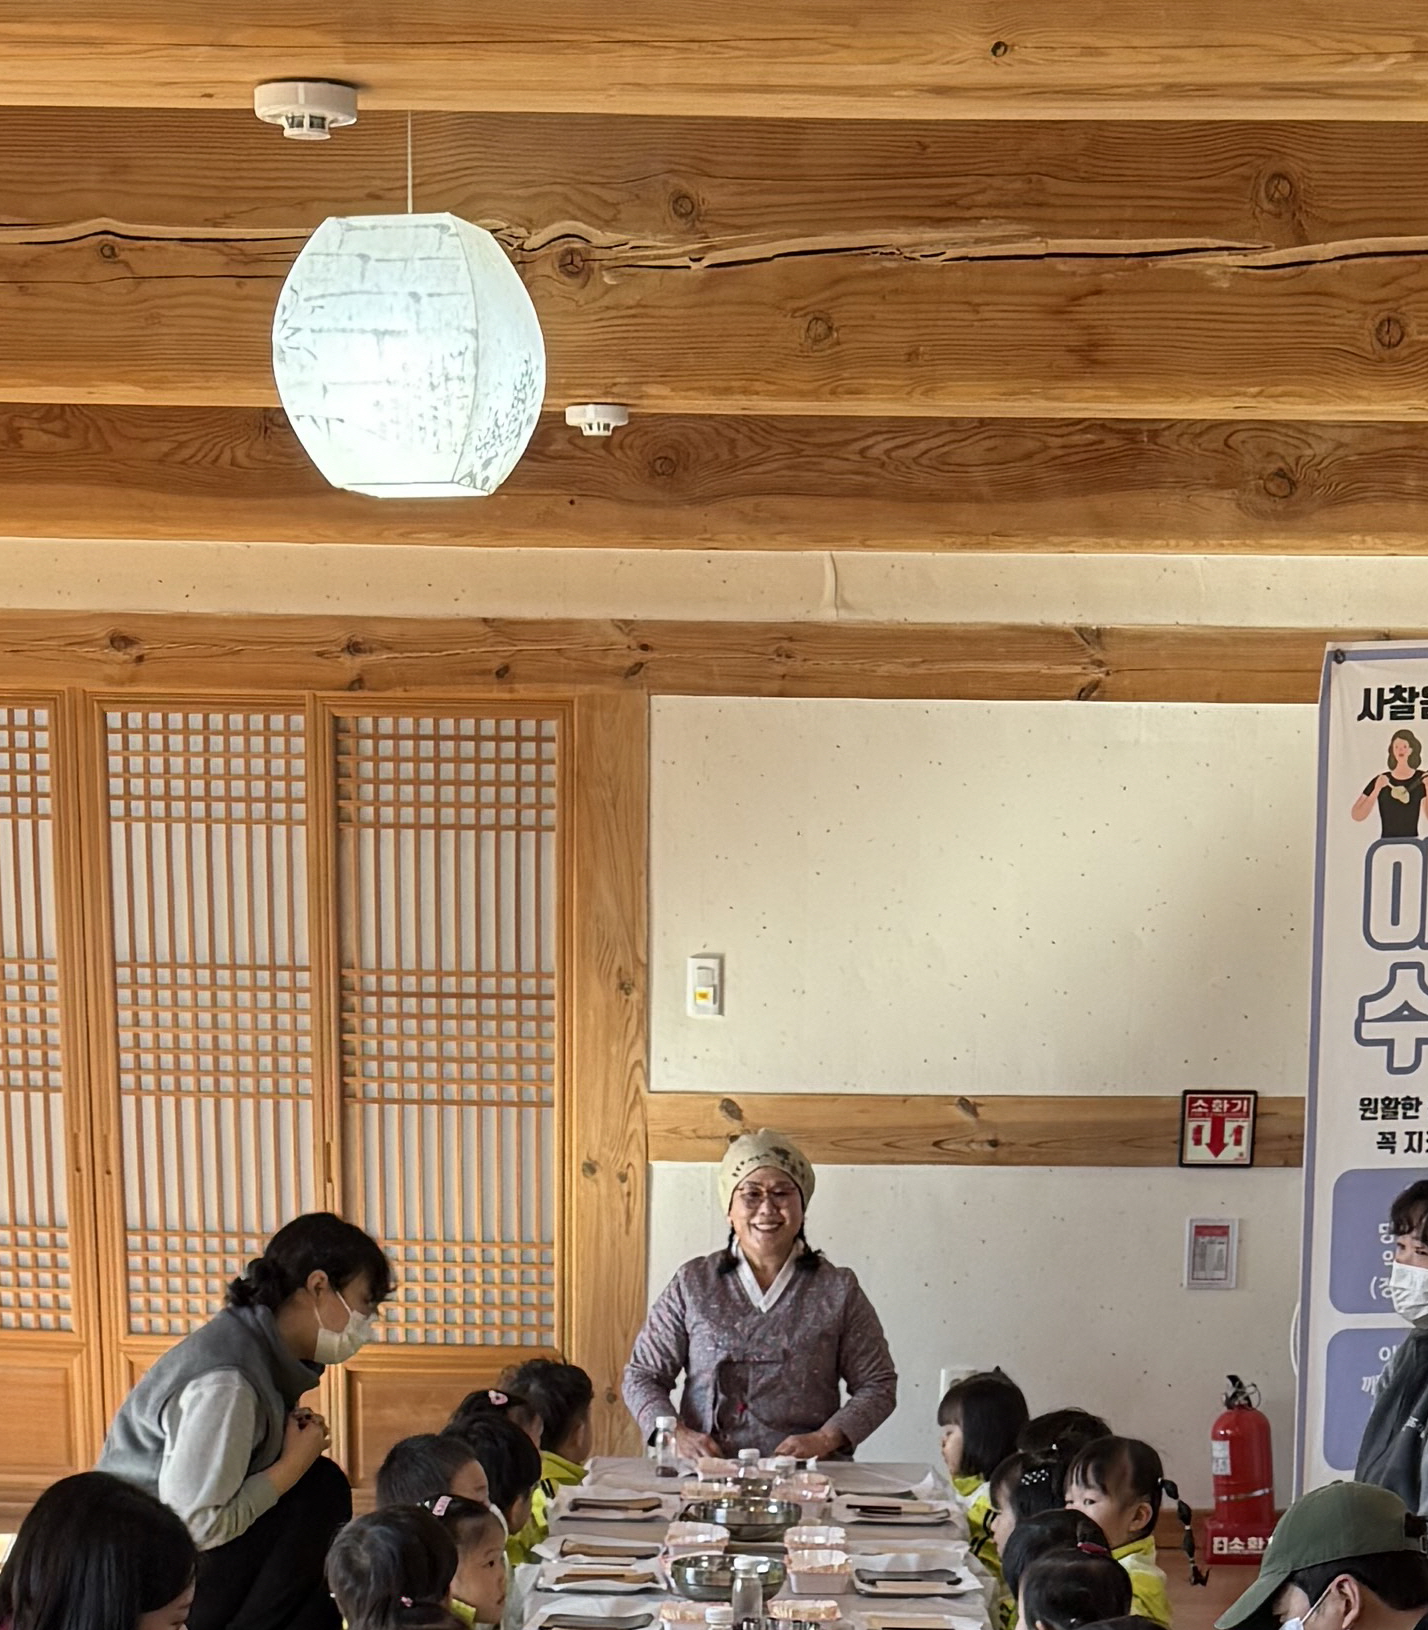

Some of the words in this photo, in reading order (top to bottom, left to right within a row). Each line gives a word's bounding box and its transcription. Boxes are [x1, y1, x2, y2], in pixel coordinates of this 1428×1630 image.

[1190, 1098, 1249, 1113] 소화기
[1359, 1095, 1423, 1121] 원활한
[1376, 1131, 1397, 1154] 꼭
[1228, 1536, 1272, 1551] 소화
